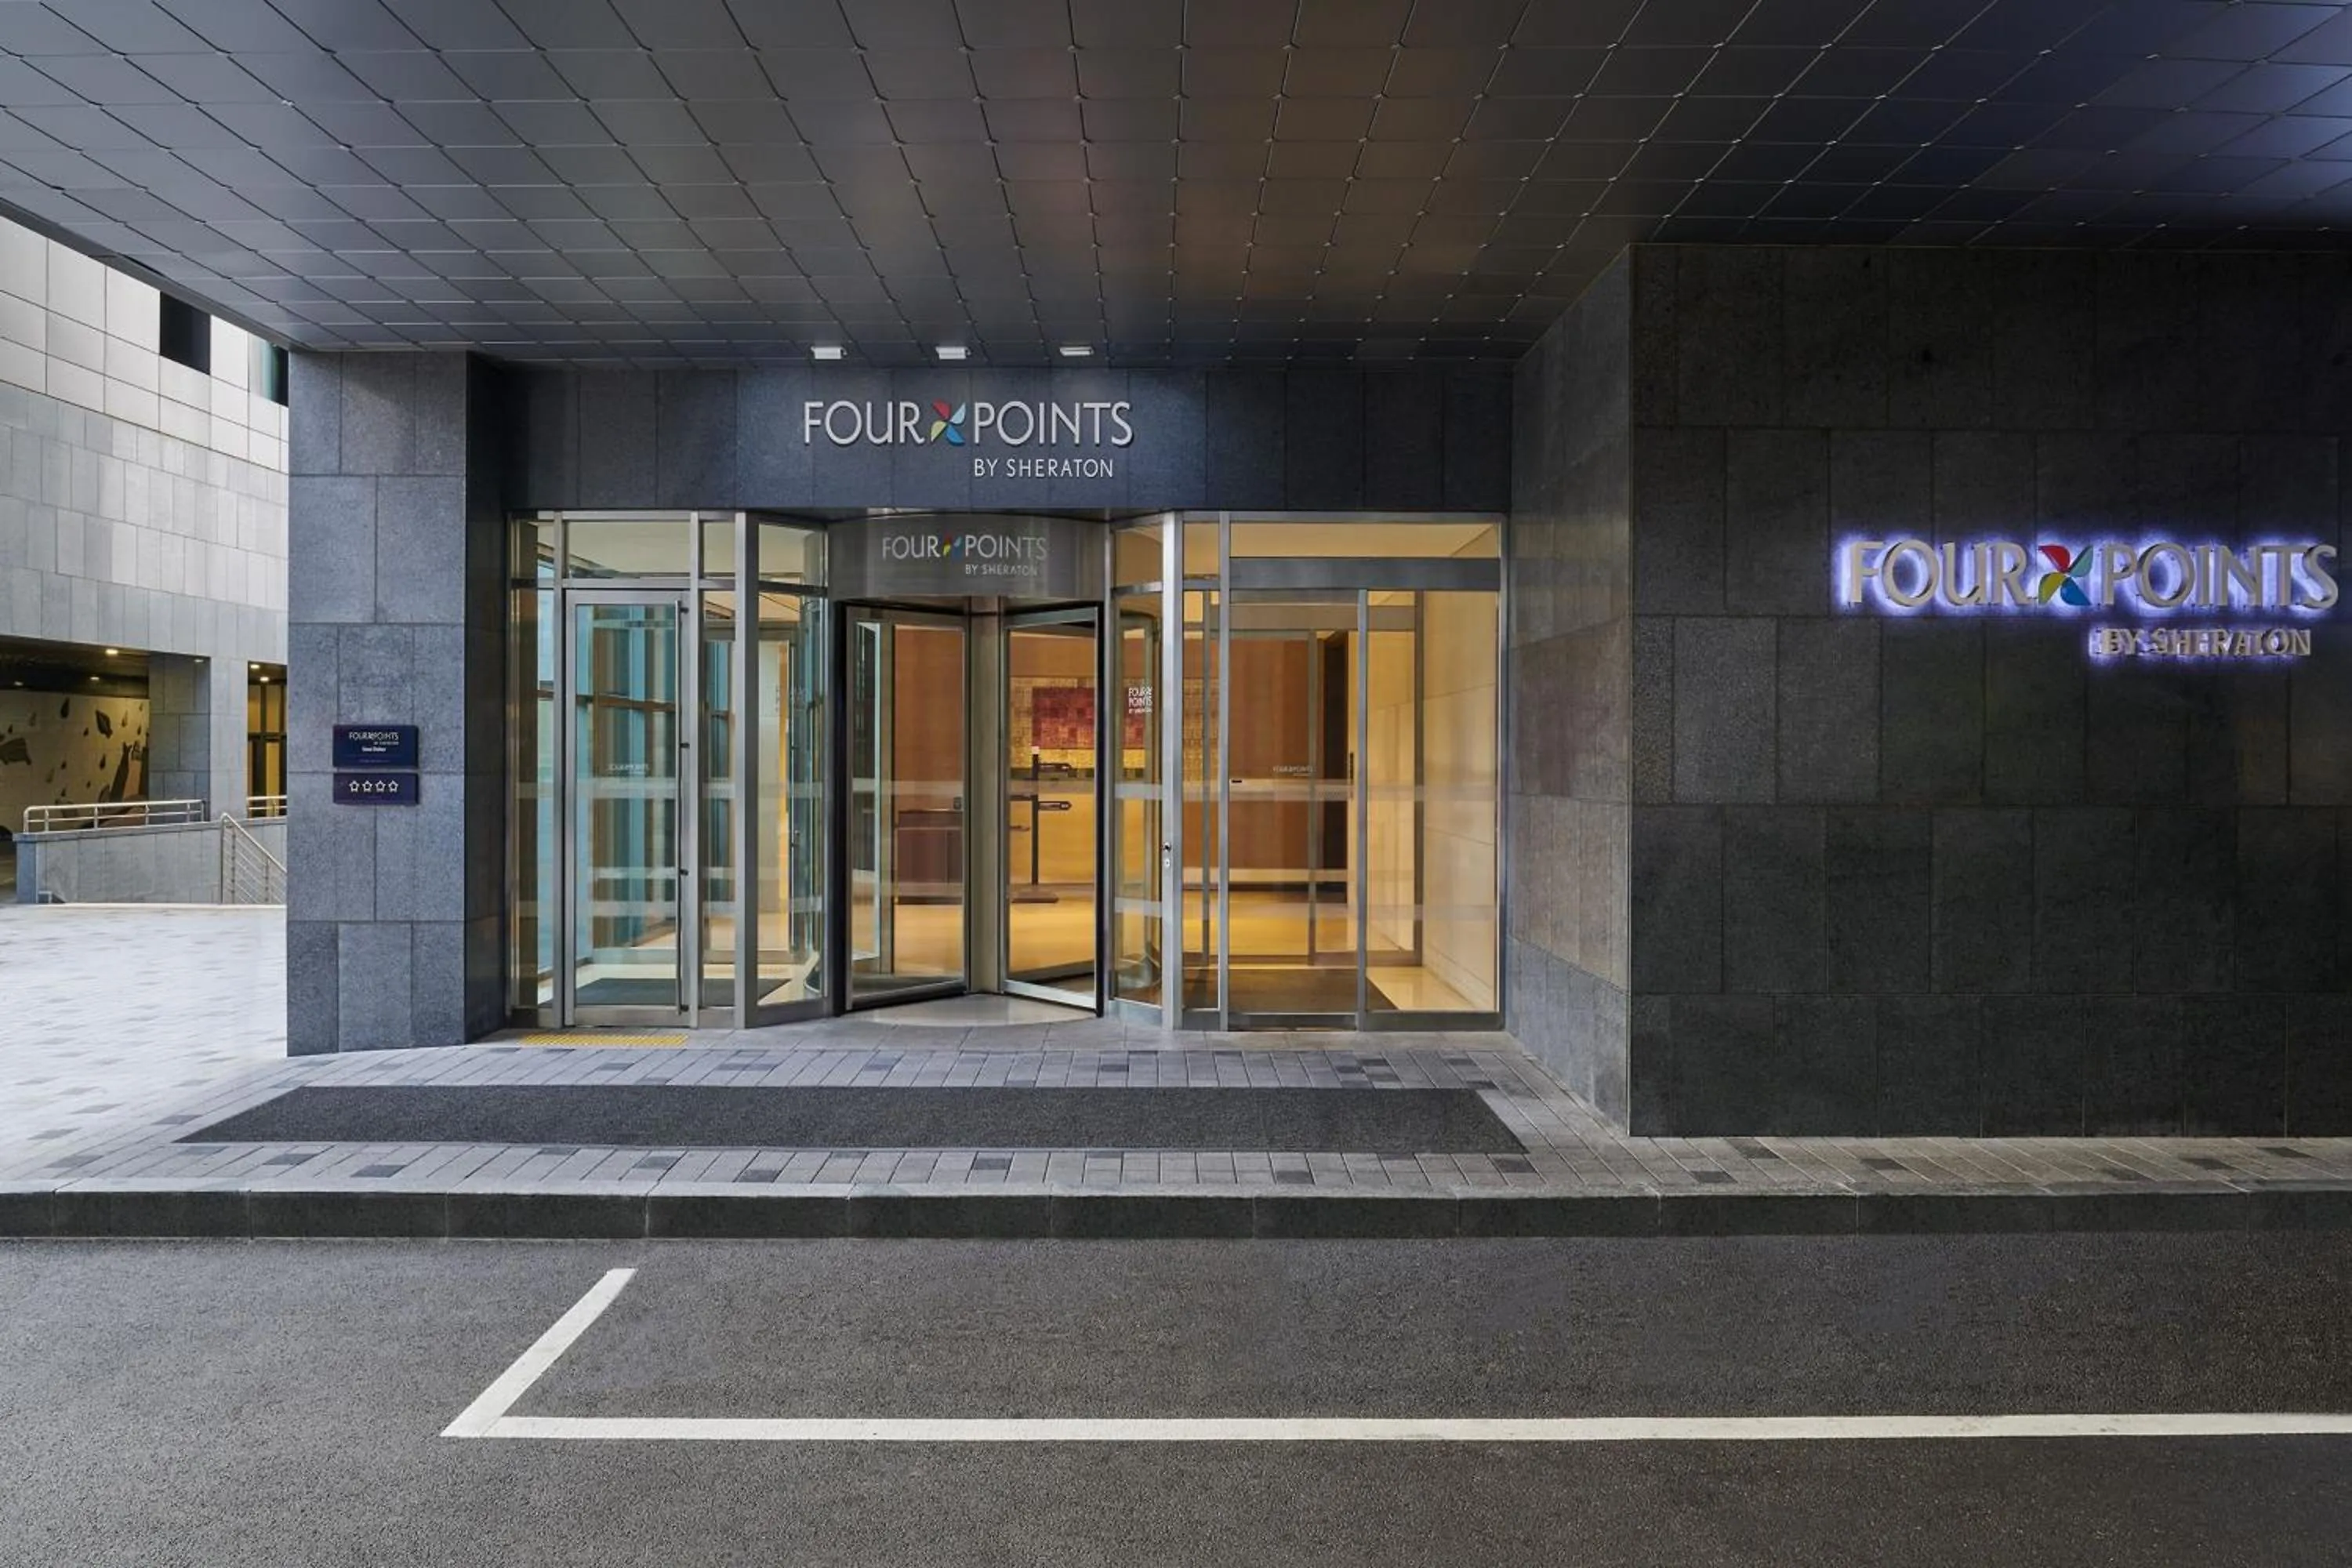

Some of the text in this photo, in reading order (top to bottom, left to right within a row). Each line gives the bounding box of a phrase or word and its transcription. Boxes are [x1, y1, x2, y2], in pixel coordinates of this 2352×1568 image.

[804, 401, 1134, 445] FOUR POINTS
[974, 459, 1113, 477] BY SHERATON
[882, 534, 1047, 561] FOUR POINTS
[965, 564, 1038, 576] BY SHERATON
[1850, 539, 2339, 608] FOUR POINTS
[2101, 628, 2311, 655] BY SHERATON
